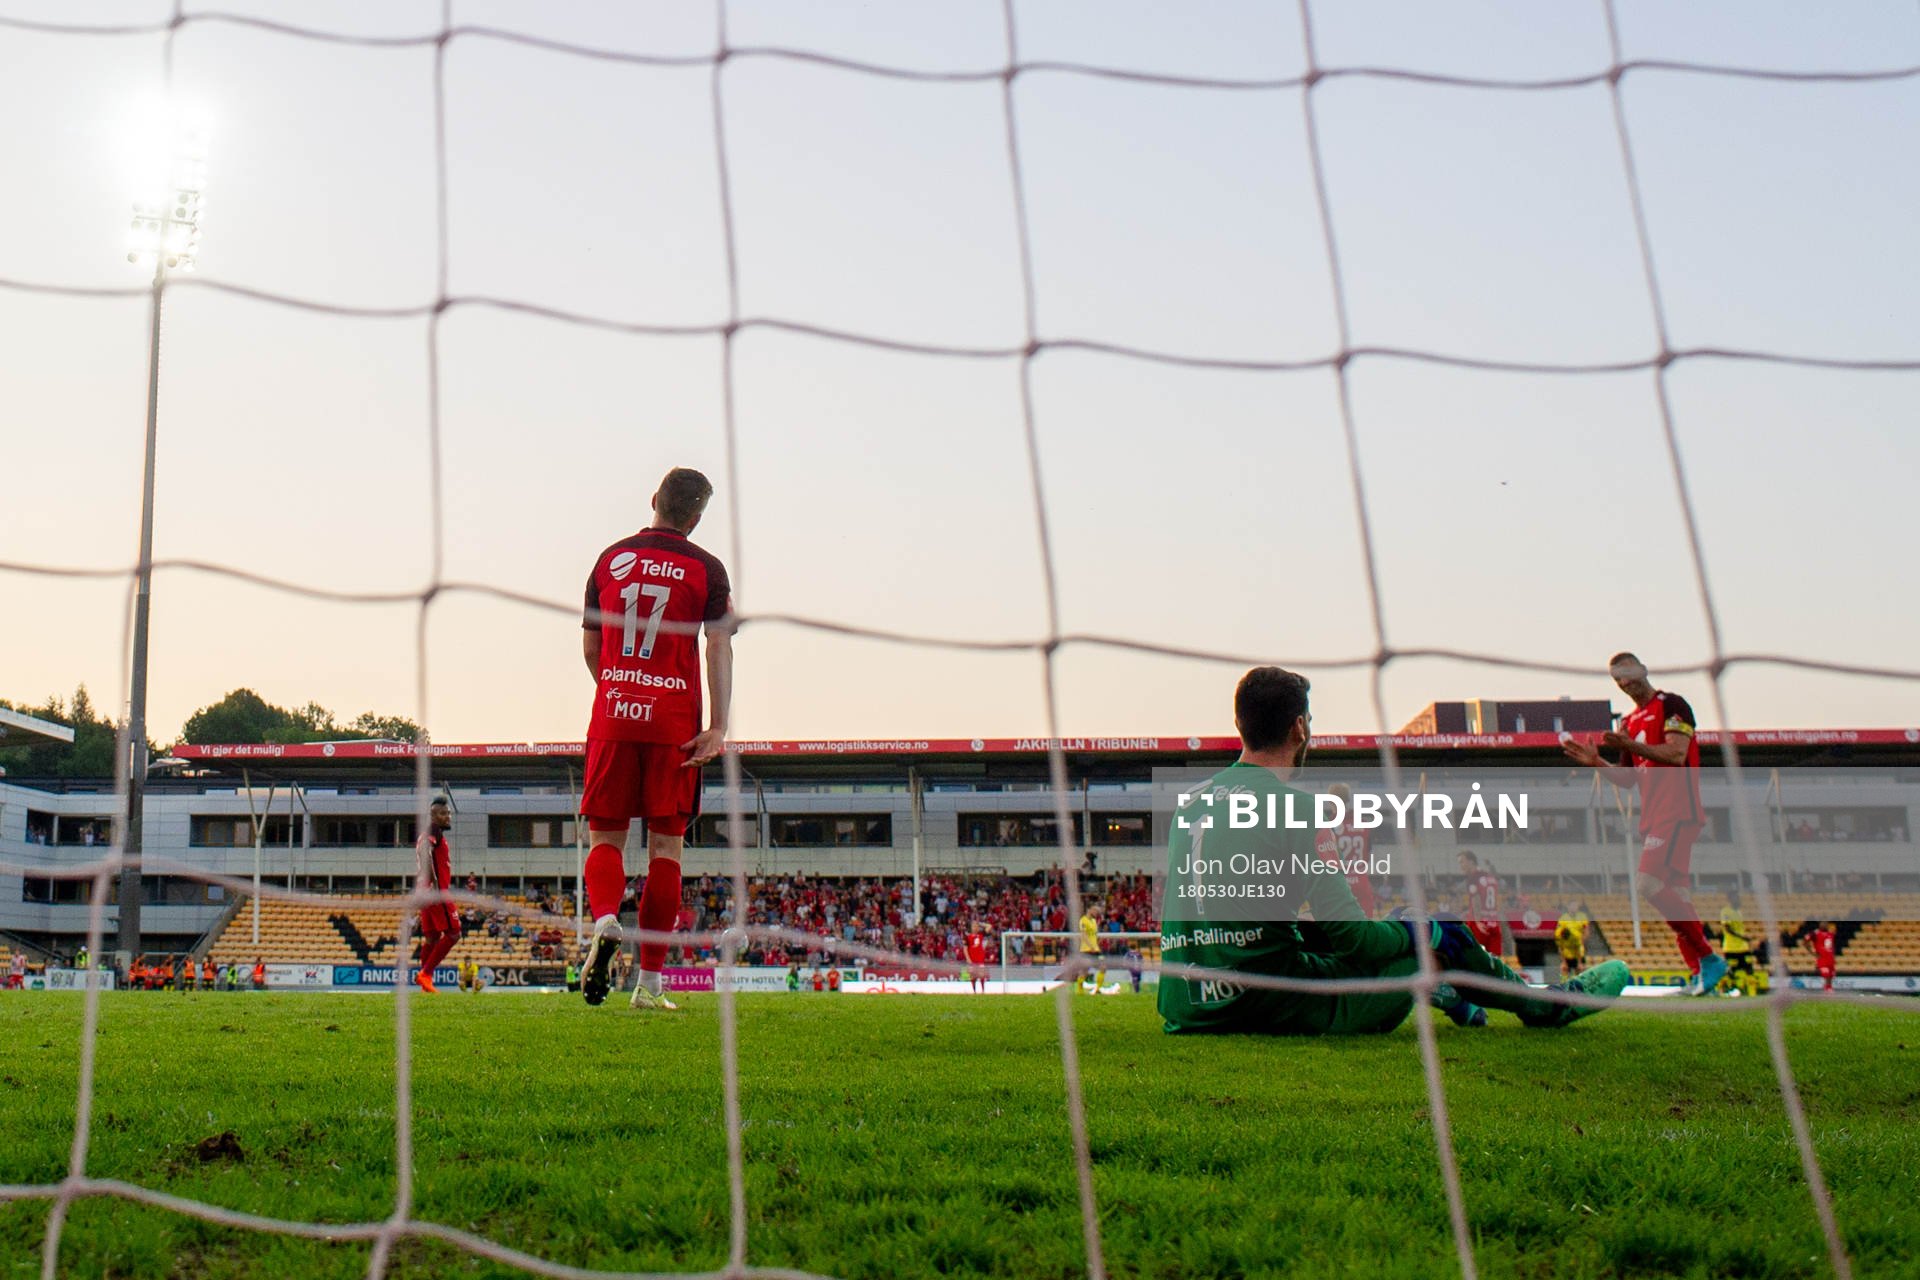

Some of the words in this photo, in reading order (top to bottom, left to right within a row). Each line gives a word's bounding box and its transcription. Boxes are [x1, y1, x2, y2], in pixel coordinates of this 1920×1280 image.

[641, 559, 685, 580] Telia
[620, 582, 671, 660] 17
[614, 701, 653, 721] MOT
[374, 744, 404, 754] Norsk
[798, 741, 928, 752] www.logistikkservice.no
[1088, 738, 1159, 750] TRIBUNEN
[200, 745, 211, 754] Vi
[234, 745, 251, 754] det
[253, 745, 285, 757] mulig!
